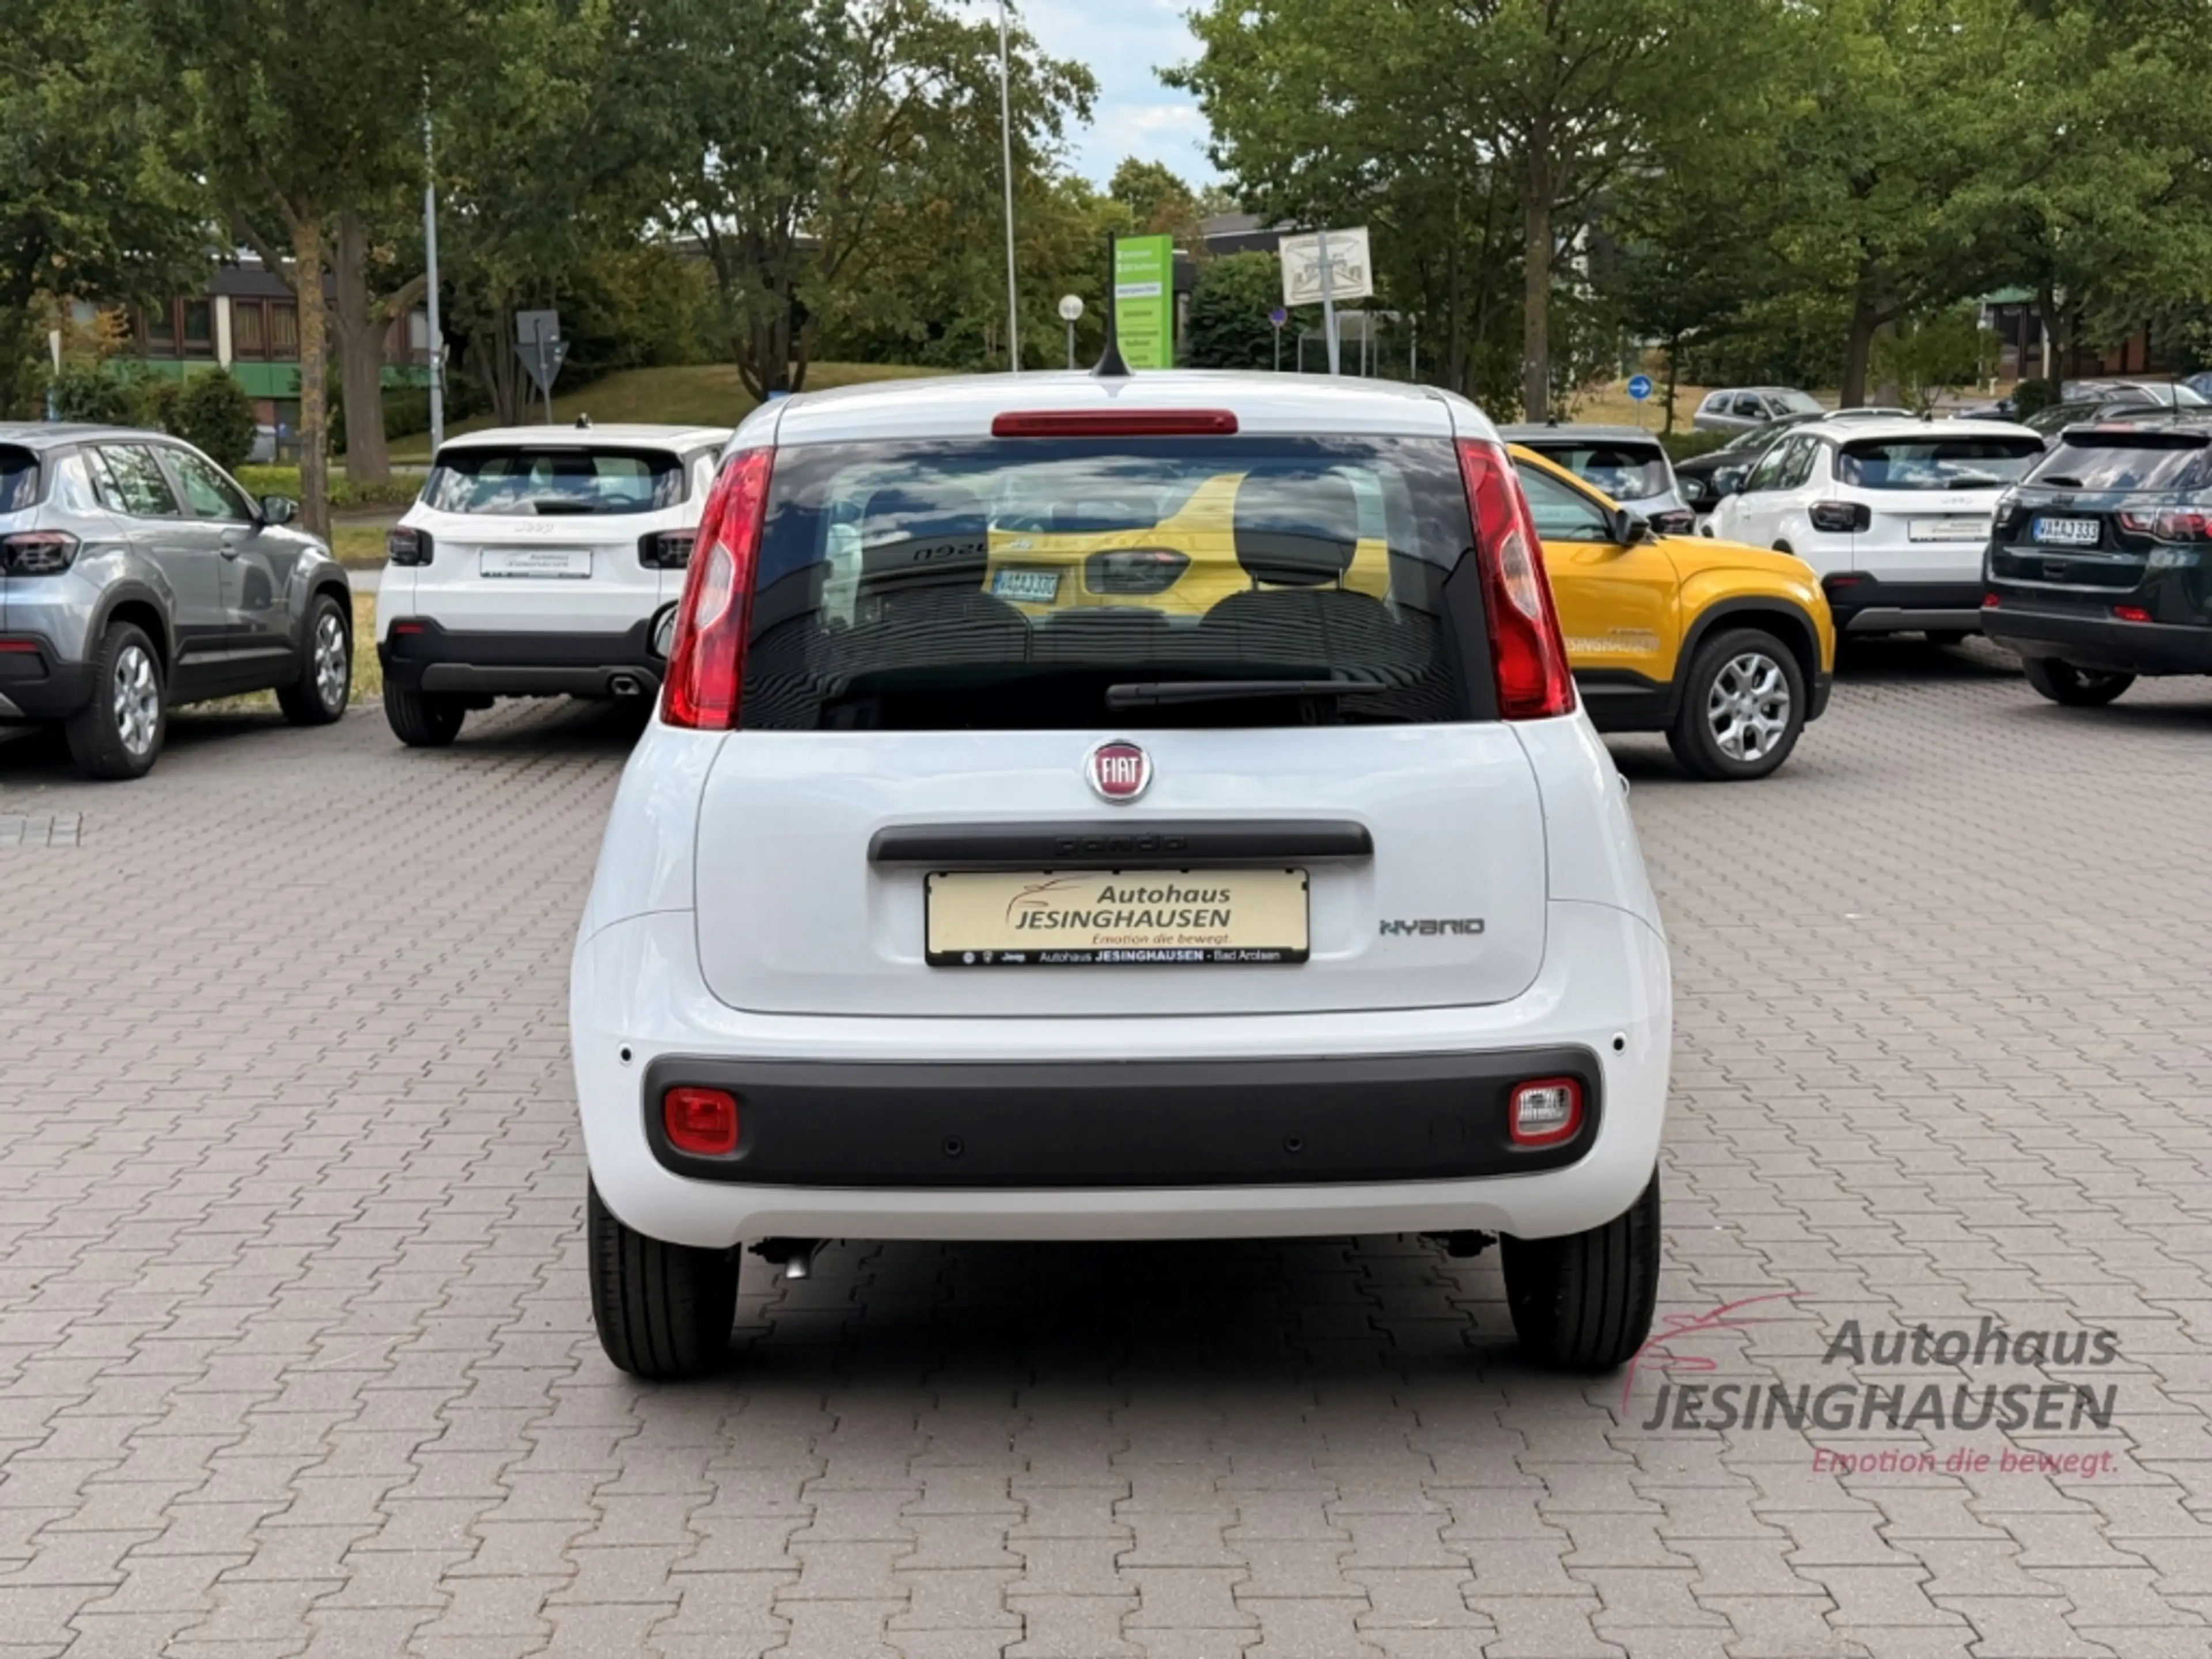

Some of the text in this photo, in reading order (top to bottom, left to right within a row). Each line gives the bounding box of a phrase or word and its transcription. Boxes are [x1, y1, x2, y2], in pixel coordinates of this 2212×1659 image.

[1101, 756, 1139, 783] FIAT
[1096, 884, 1230, 904] Autohaus
[1015, 909, 1232, 930] JESINGHAUSEN
[1379, 917, 1485, 936] HYBRID
[1092, 933, 1149, 945] Emotion
[1153, 933, 1174, 944] die
[1039, 951, 1092, 962] Autohaus
[1095, 950, 1204, 961] JESINGHAUSEN
[1214, 950, 1236, 960] Bad
[1238, 950, 1281, 961] Arolsen
